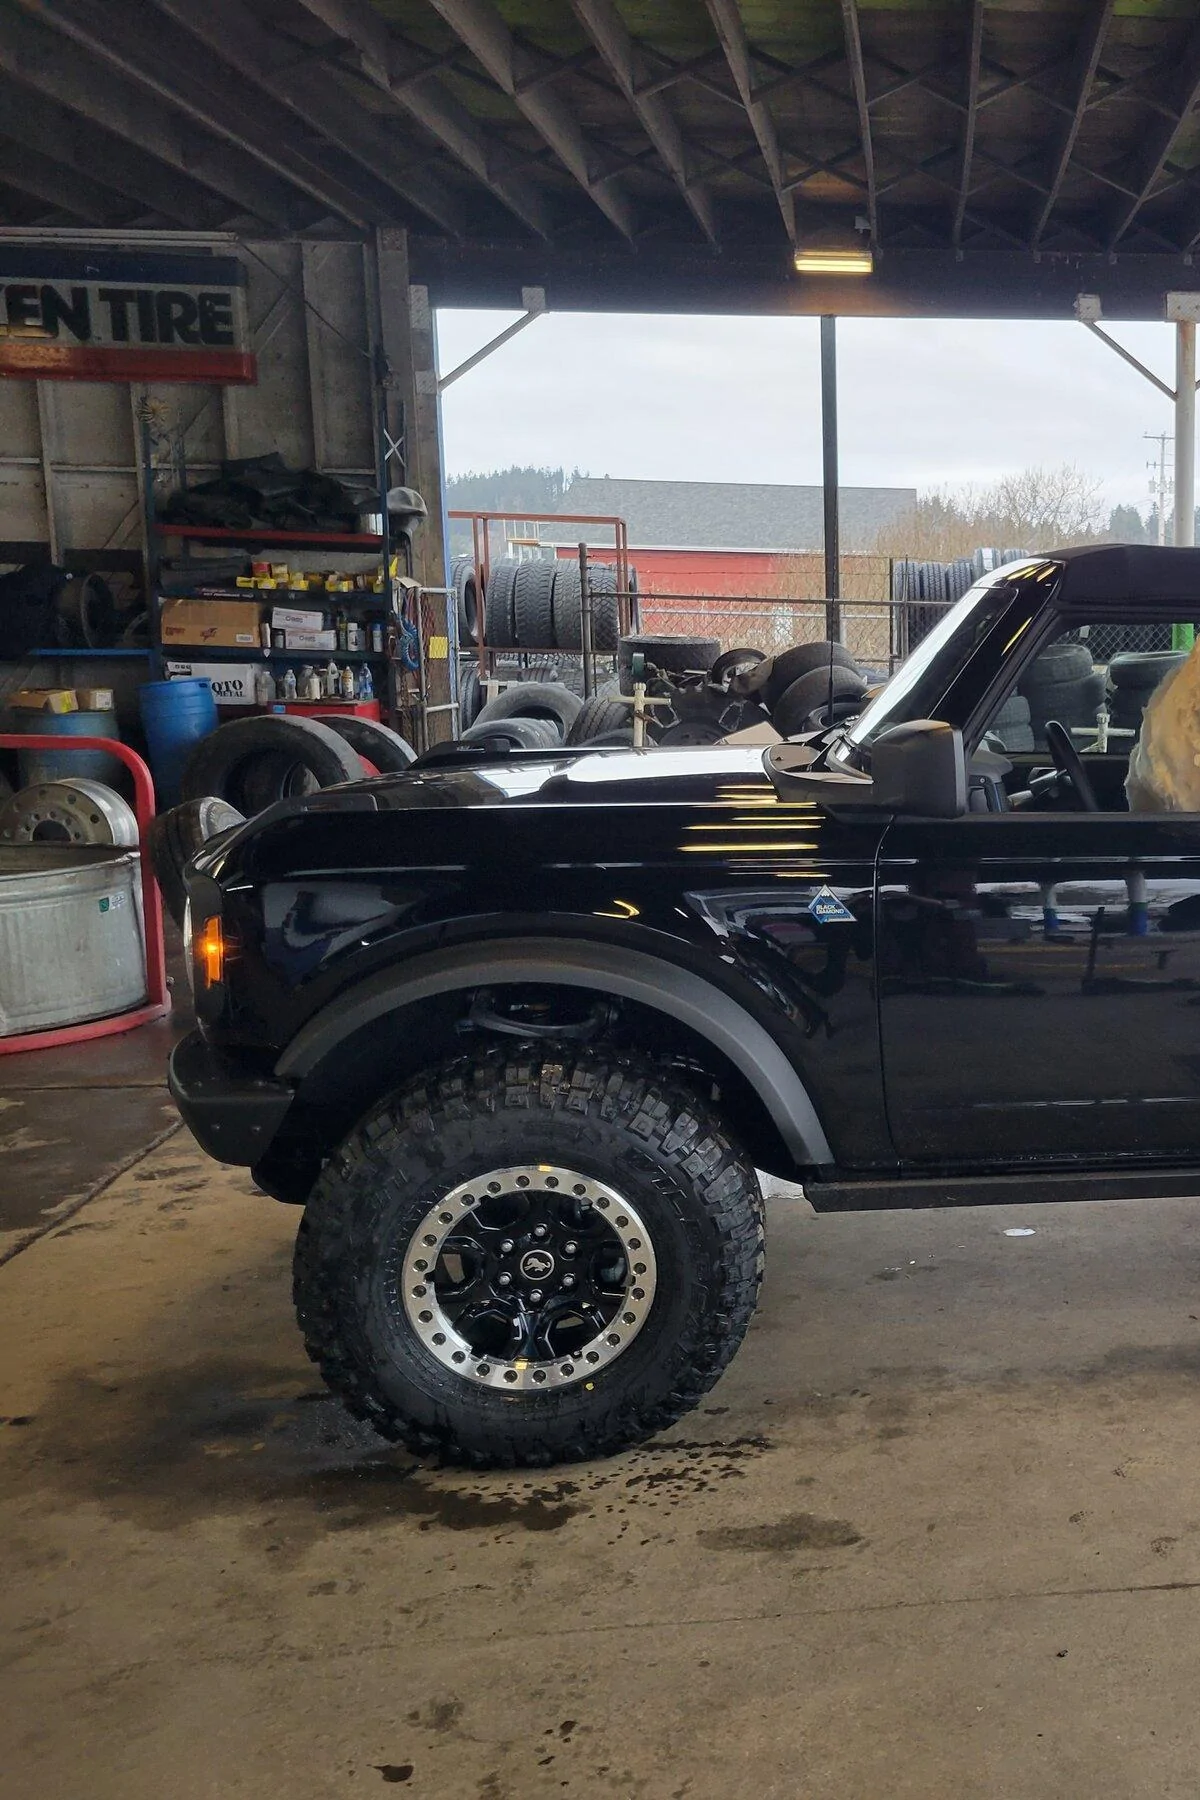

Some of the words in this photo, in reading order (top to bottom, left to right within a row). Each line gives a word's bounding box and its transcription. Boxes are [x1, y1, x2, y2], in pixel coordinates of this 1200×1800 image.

[0, 283, 91, 341] EN
[99, 287, 235, 345] TIRE
[211, 679, 243, 693] OTO
